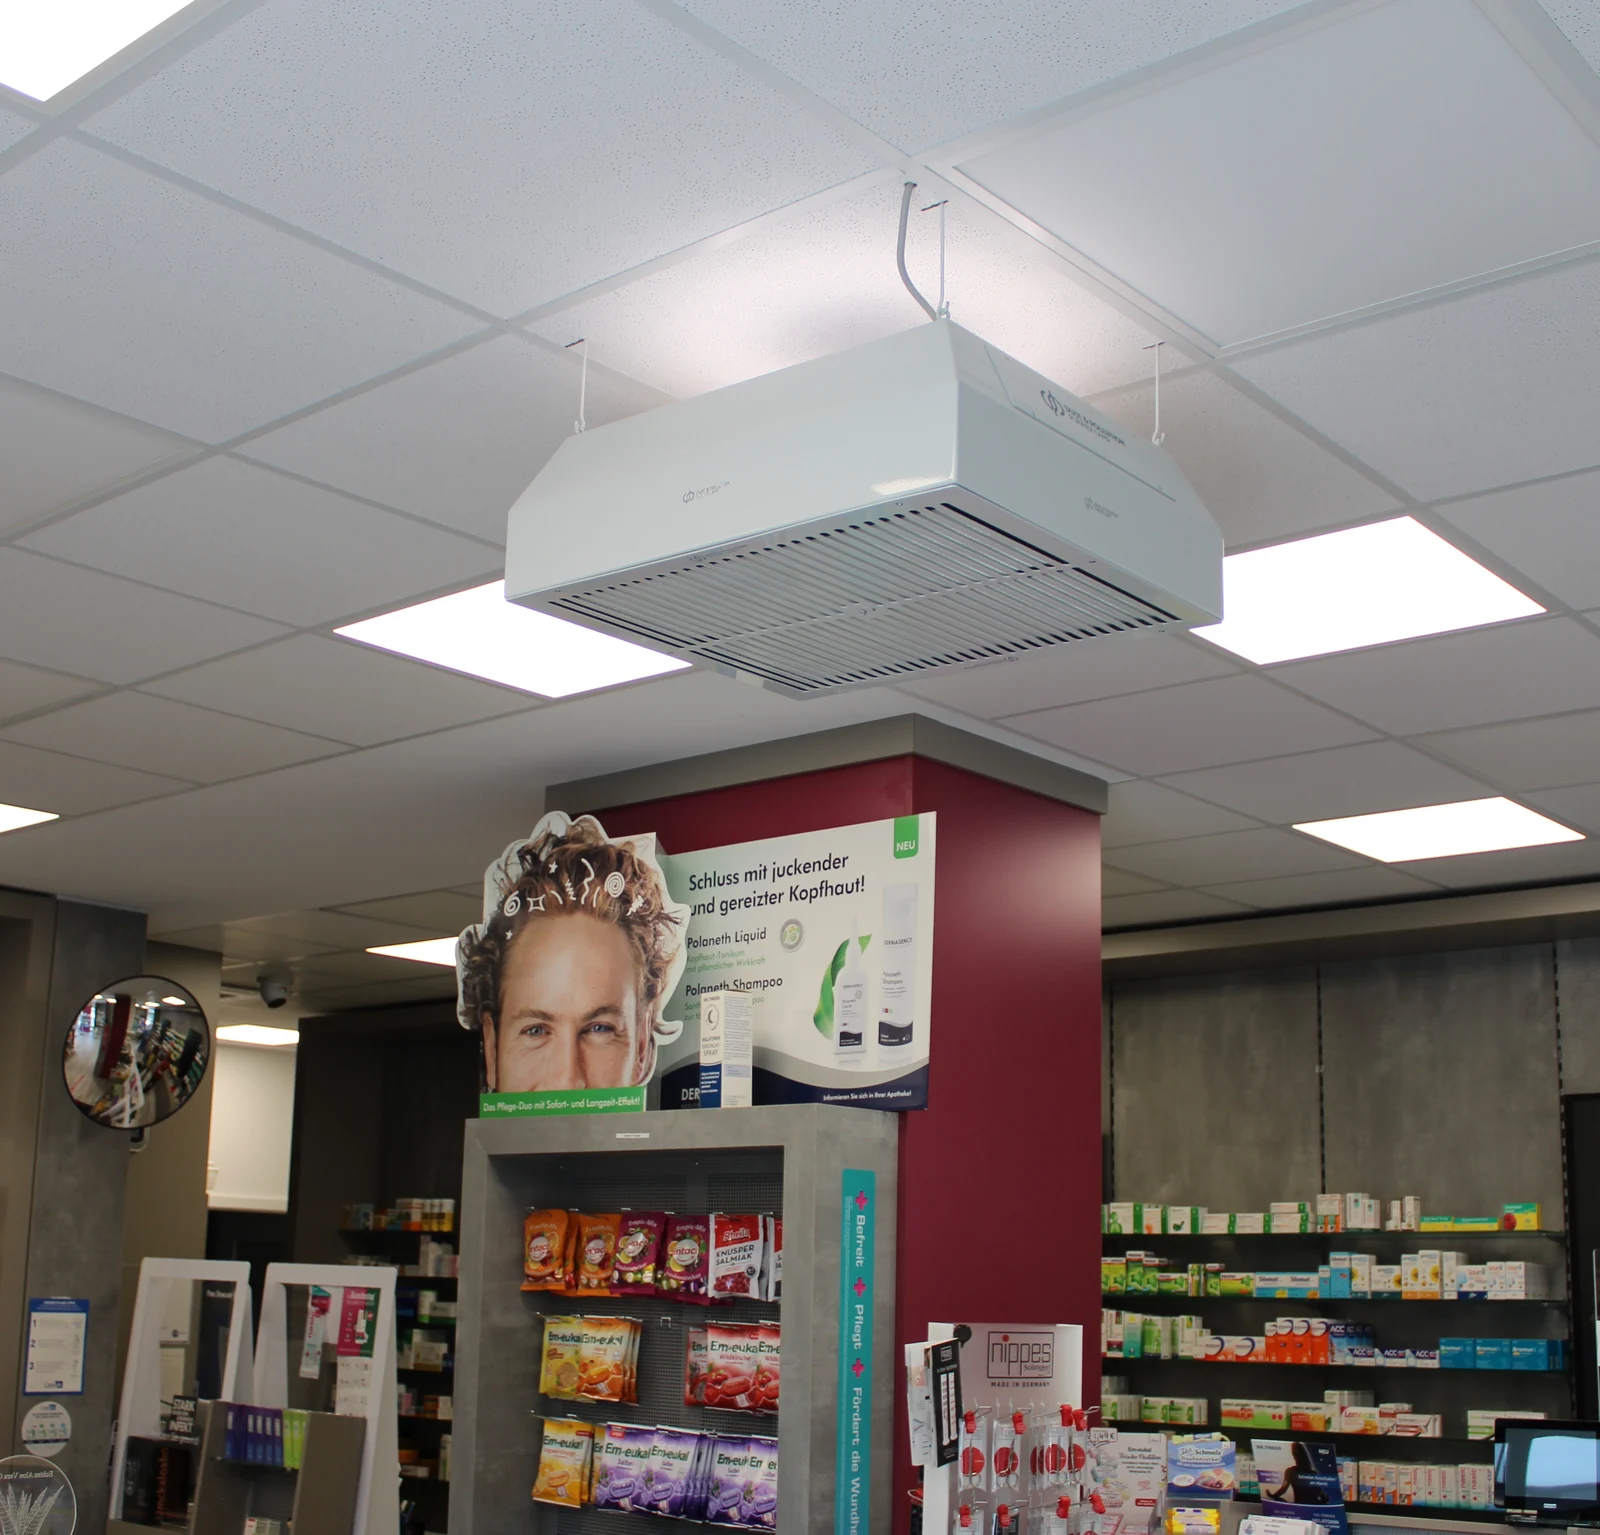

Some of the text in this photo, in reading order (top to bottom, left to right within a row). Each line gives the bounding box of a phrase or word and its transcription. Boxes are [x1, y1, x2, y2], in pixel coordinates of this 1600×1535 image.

[896, 839, 916, 852] NEU
[689, 853, 849, 892] Schluss mit juckender
[691, 875, 865, 916] und gereizter Kopfhaut!
[687, 927, 767, 949] Polaneth Liquid
[736, 956, 766, 967] Wirkkraft
[685, 977, 783, 996] Polaneth Shampoo
[887, 1090, 912, 1099] Apotheke!
[483, 1097, 640, 1113] Das Pflege-Duo mit Sofort- und Langzeit-Effekt!
[855, 1214, 866, 1267] Befreit
[716, 1244, 755, 1258] KNUSPER
[715, 1253, 752, 1266] SALMIAK
[852, 1304, 864, 1350] Pflegt
[1330, 1325, 1345, 1333] ACC
[710, 1341, 758, 1353] Em-euka
[991, 1334, 1052, 1376] nippes
[1384, 1349, 1398, 1357] ACC
[1415, 1350, 1429, 1358] ACC
[852, 1387, 863, 1446] Fördert
[544, 1435, 584, 1449] Em-eukal
[605, 1442, 651, 1459] Em-eukal
[651, 1445, 689, 1461] Em-eukal
[717, 1453, 749, 1466] Em-euk
[851, 1450, 861, 1472] die
